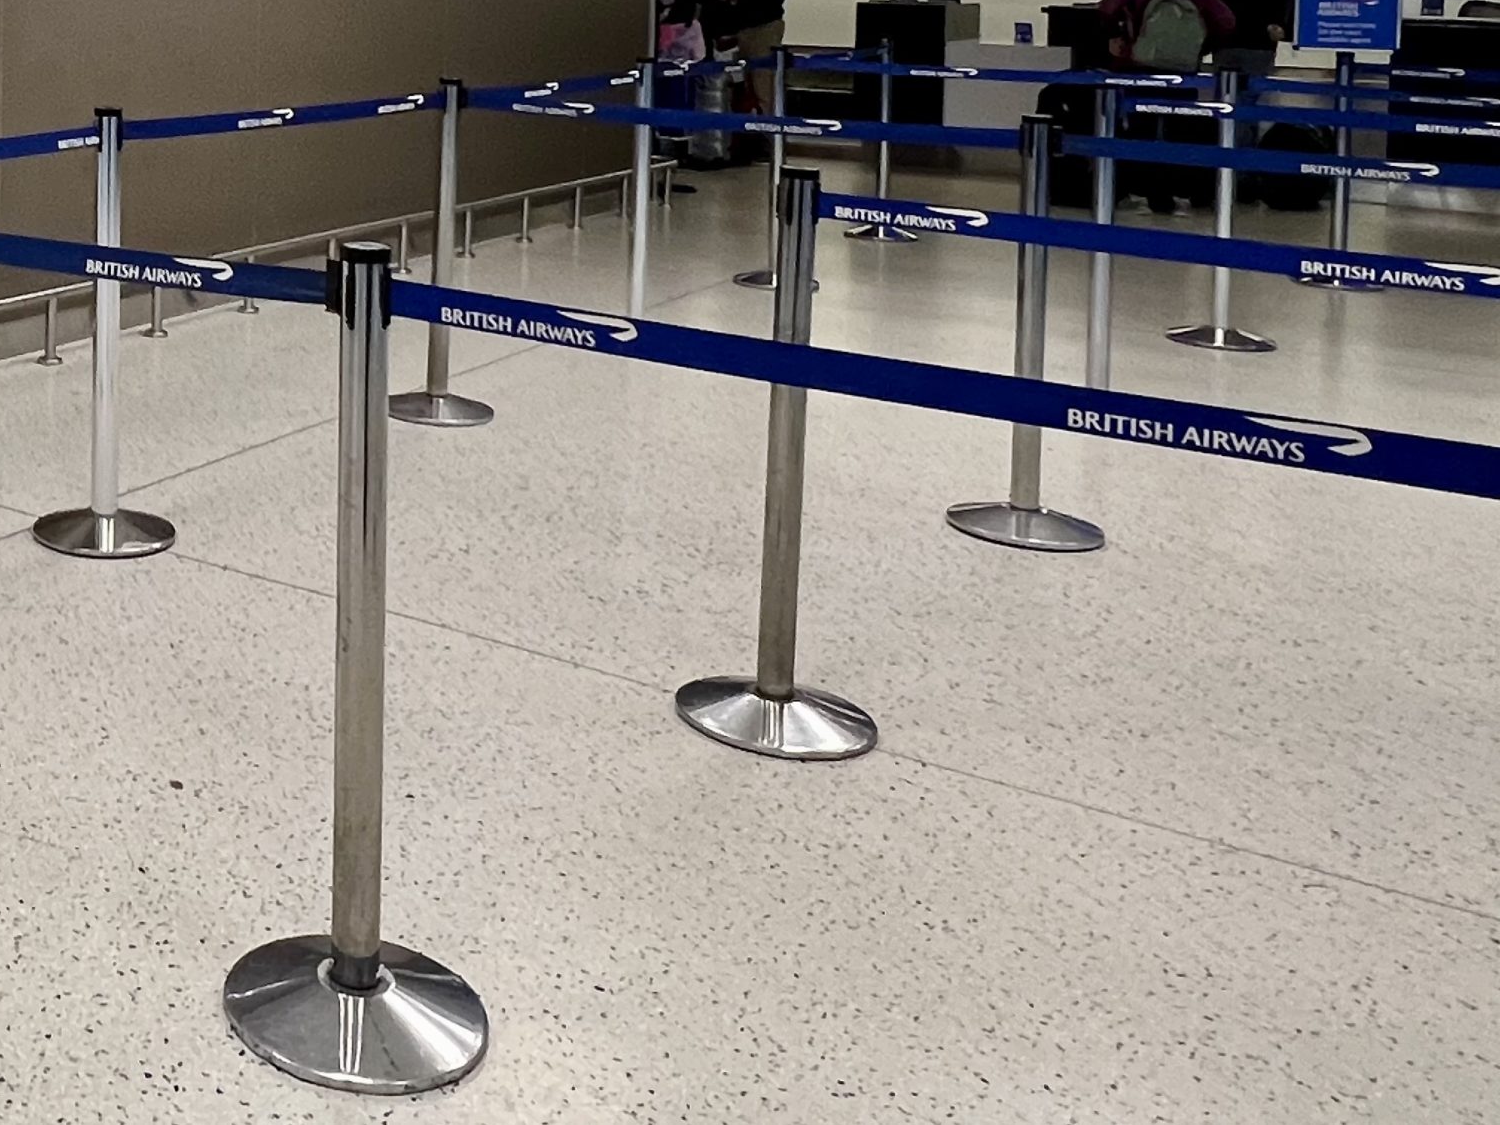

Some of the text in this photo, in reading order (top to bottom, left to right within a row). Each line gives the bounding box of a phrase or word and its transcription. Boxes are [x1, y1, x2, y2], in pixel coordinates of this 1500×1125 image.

[1300, 164, 1411, 181] BRITISH AIRWAYS
[834, 206, 957, 231] BRITISH AIRWAYS
[85, 258, 202, 288] BRITISH AIRWAYS
[1300, 260, 1465, 291] BRITISH AIRWAYS
[440, 306, 596, 348] BRITISH AIRWAYS
[1067, 408, 1305, 463] BRITISH AIRWAYS
